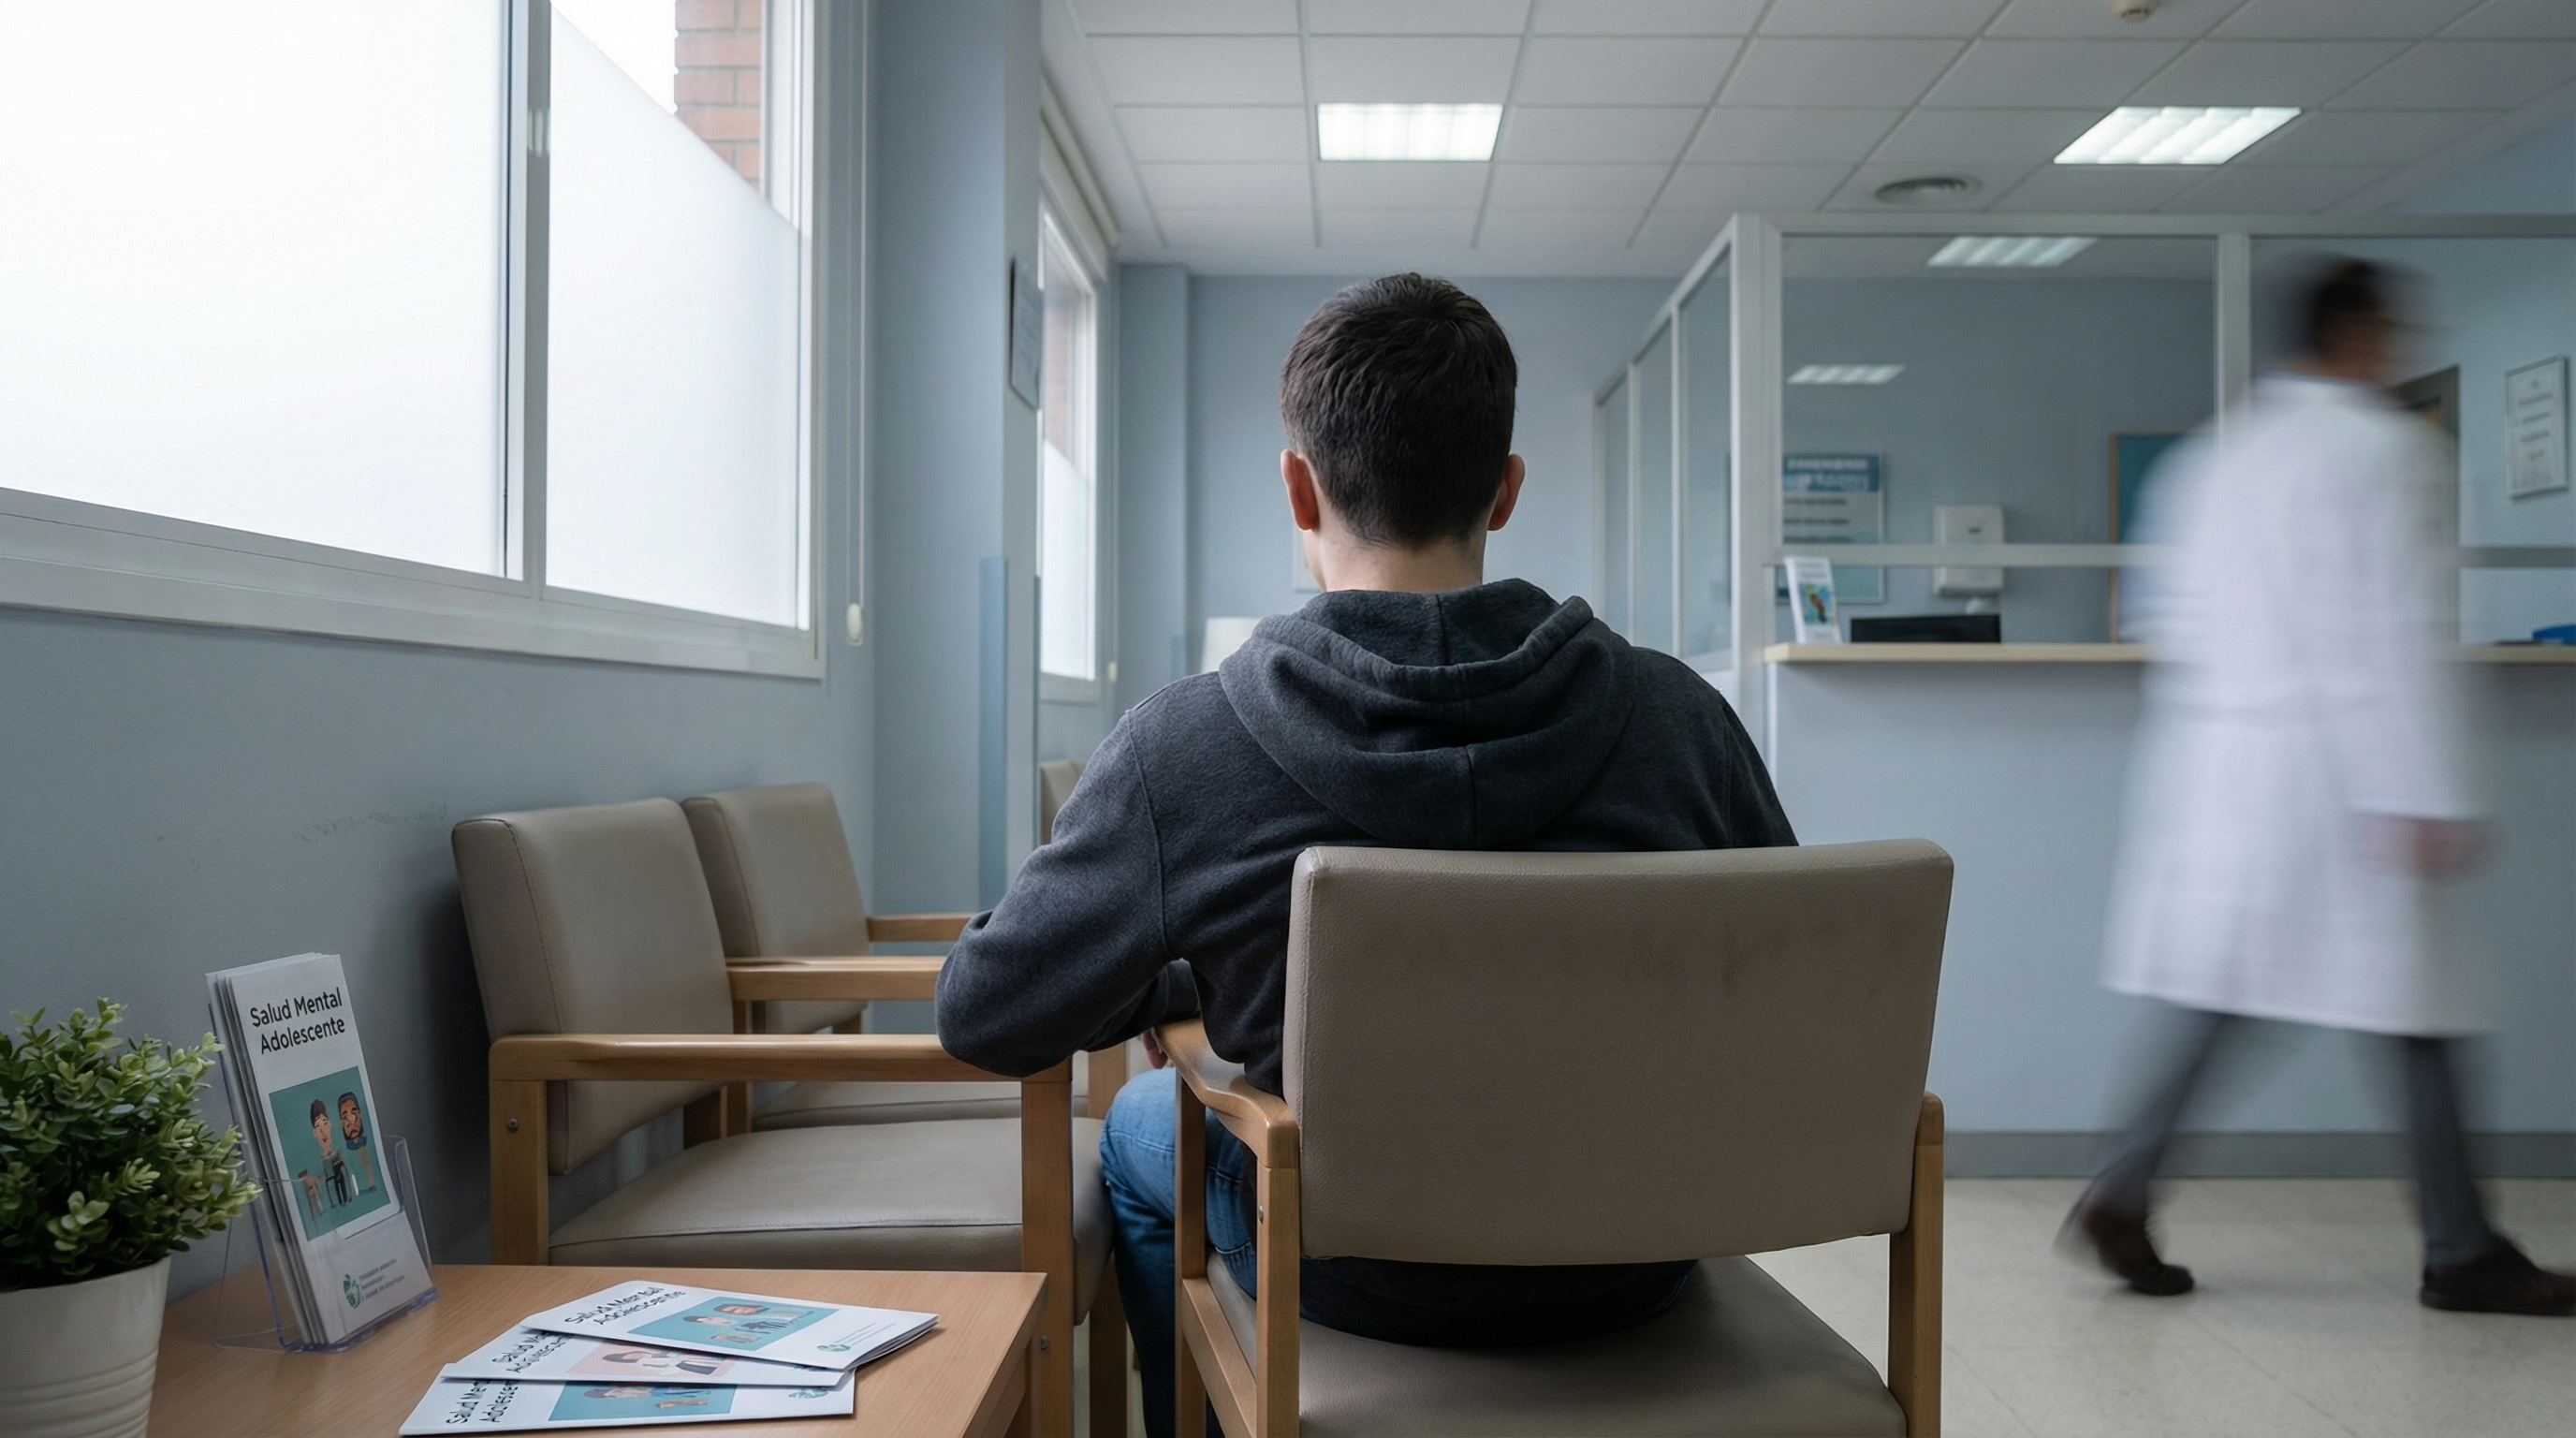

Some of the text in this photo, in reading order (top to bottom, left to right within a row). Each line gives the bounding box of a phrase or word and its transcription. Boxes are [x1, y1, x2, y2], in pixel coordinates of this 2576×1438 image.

[250, 987, 343, 1027] Salud Mental
[261, 1017, 345, 1055] Adolescente
